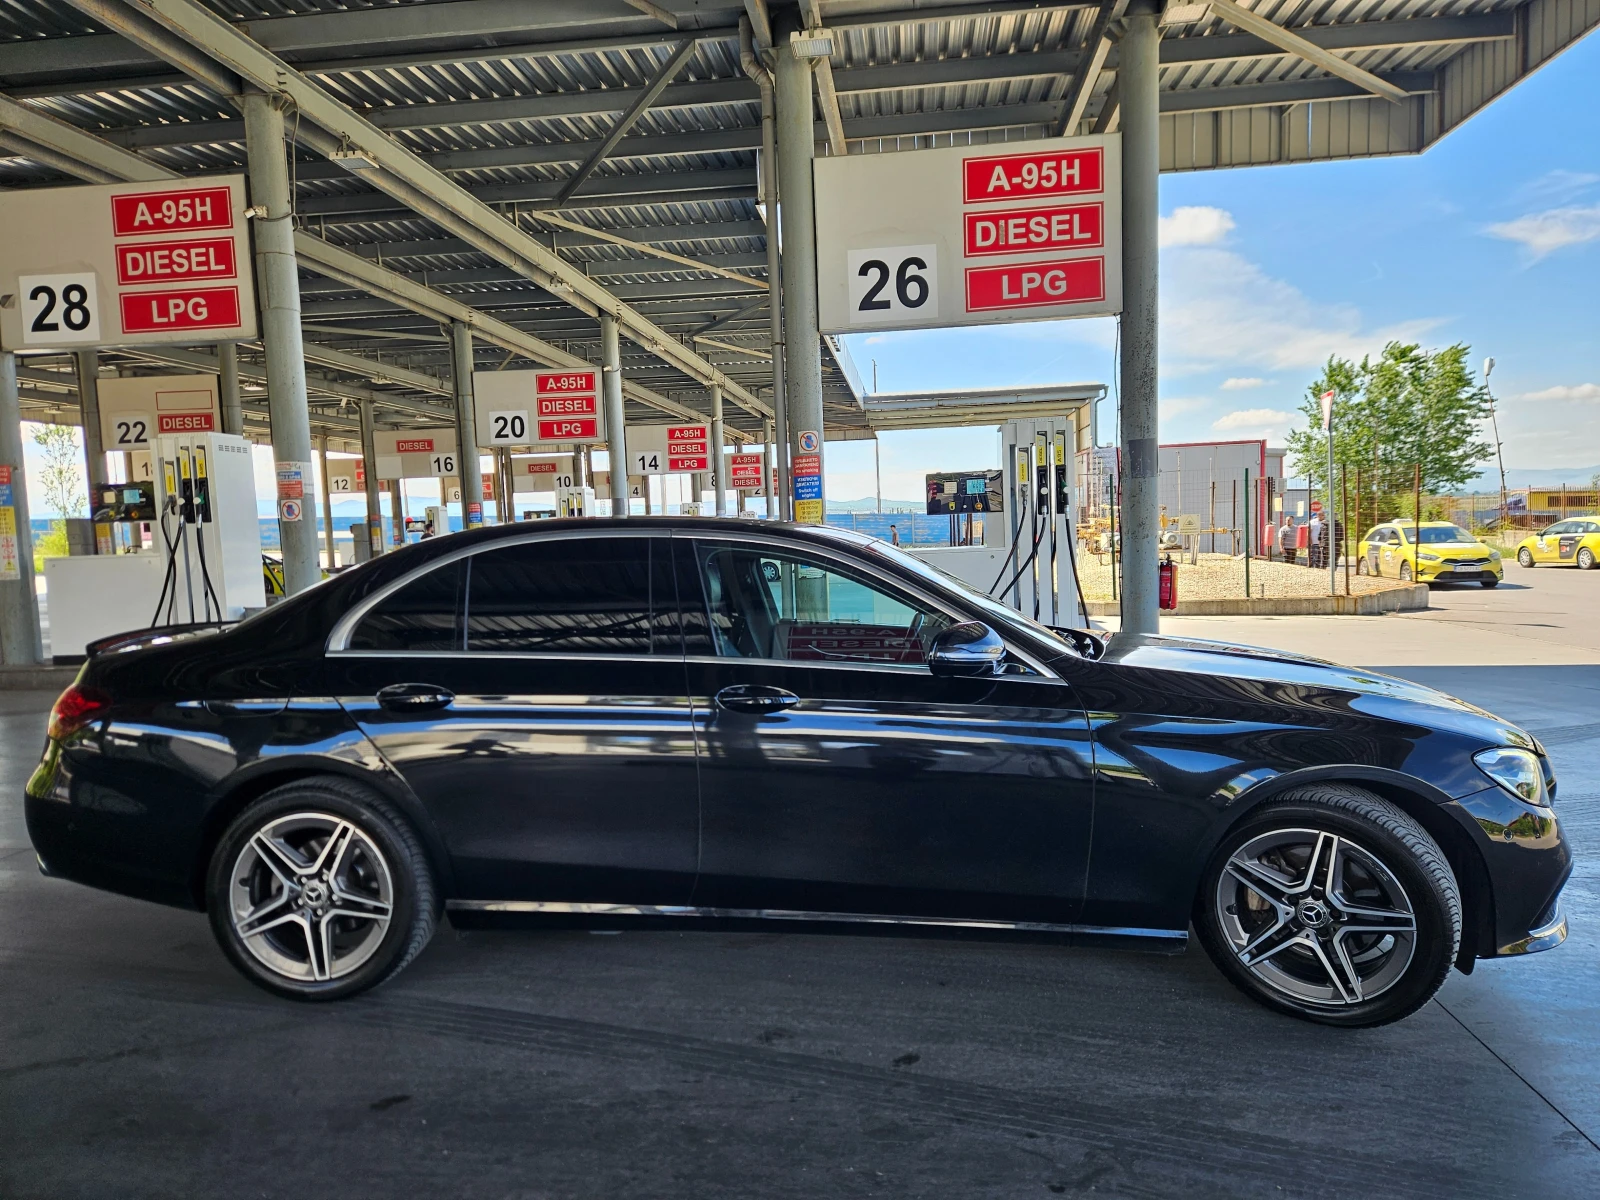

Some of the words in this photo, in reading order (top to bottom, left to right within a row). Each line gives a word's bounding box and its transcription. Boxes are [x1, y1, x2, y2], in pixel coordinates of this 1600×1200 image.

[987, 158, 1081, 193] A-95H
[133, 197, 213, 227] A-95H
[975, 213, 1092, 248] DIESEL
[125, 247, 226, 277] DIESEL
[858, 256, 929, 311] 26
[1002, 270, 1067, 300] LPG
[29, 283, 91, 333] 28
[151, 297, 209, 323] LPG
[546, 376, 586, 390] A-95H
[542, 400, 592, 413] DIESEL
[162, 416, 210, 430] DIESEL
[494, 415, 525, 439] 20
[553, 423, 582, 436] LPG
[117, 421, 148, 444] 22
[674, 429, 701, 438] A-95H
[399, 441, 431, 451] DIESEL
[671, 444, 704, 453] DIESEL
[433, 456, 454, 473] 16
[638, 455, 659, 471] 14
[678, 459, 698, 468] LPG
[736, 456, 757, 464] A-95H
[530, 464, 555, 472] DIESEL
[333, 479, 349, 491] 12
[556, 475, 571, 488] 10
[734, 478, 759, 486] DIESEL
[454, 490, 460, 500] 6
[632, 486, 639, 496] 4
